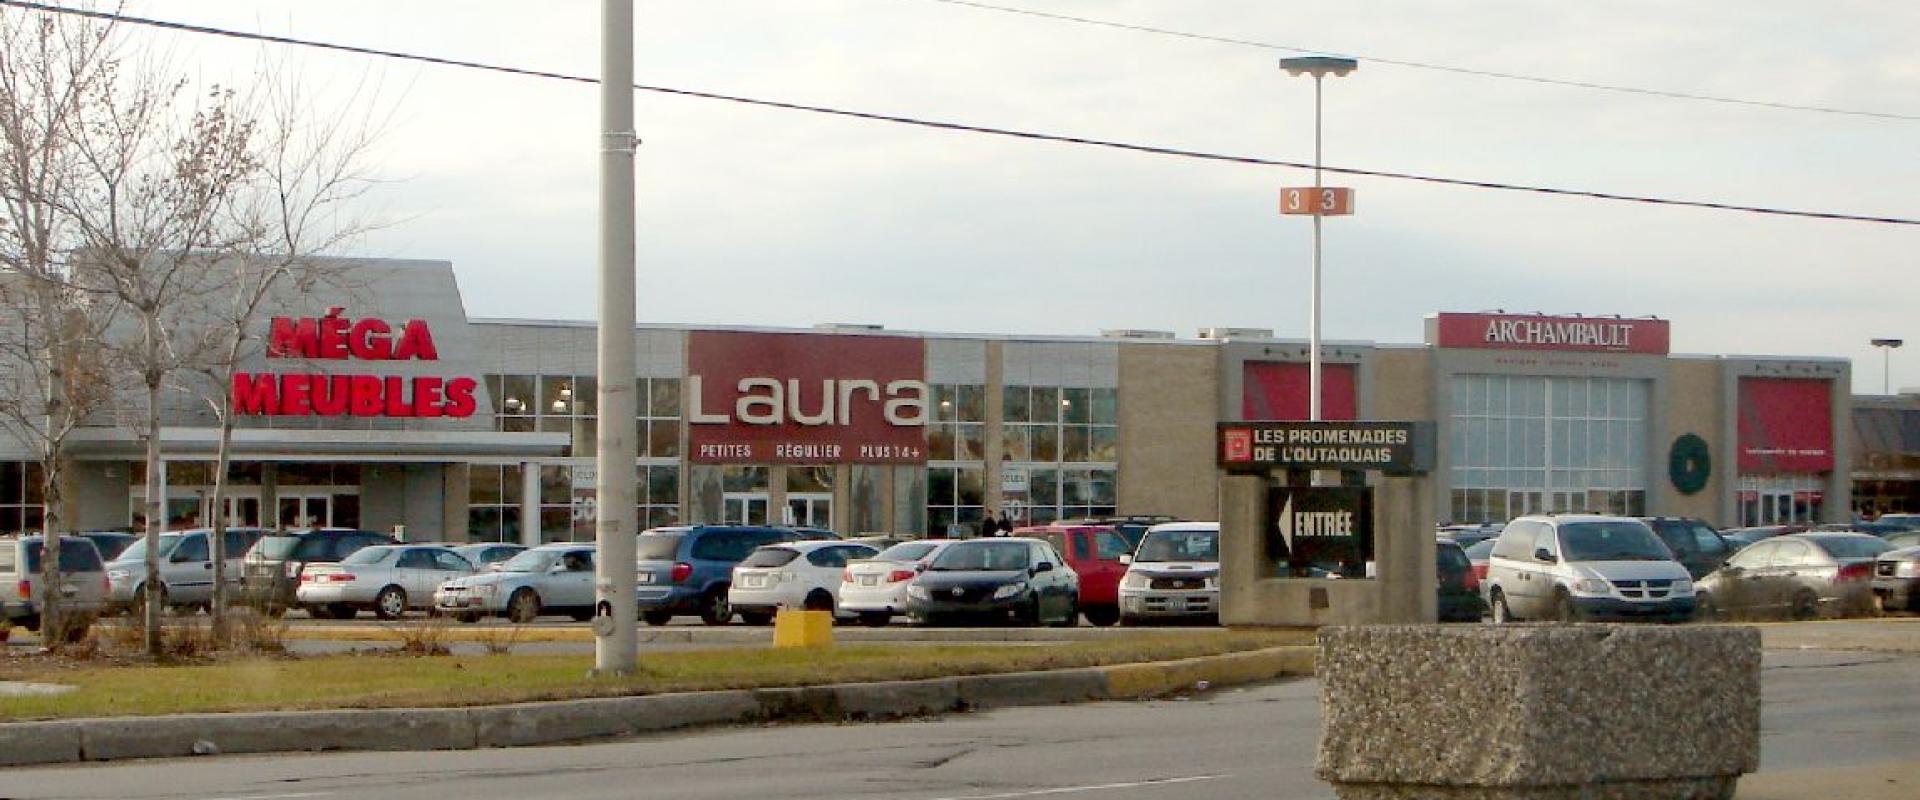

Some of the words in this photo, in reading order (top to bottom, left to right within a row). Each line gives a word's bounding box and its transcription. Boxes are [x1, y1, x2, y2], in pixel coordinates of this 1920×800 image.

[1288, 190, 1300, 210] 3
[1322, 190, 1336, 210] 3
[266, 307, 438, 360] MÉGA
[1486, 319, 1633, 346] ARCHAMBAULT
[232, 372, 478, 417] MEUBLES
[689, 374, 928, 426] Laura
[1254, 429, 1284, 444] LES
[1289, 429, 1407, 444] PROMENADES
[700, 444, 752, 458] PETITES
[776, 442, 842, 458] RÉGULIER
[860, 445, 890, 458] PLUS
[1254, 447, 1280, 462] DE
[1283, 447, 1392, 463] L'OUTAOUAIS
[1295, 509, 1352, 537] ENTRÉE
